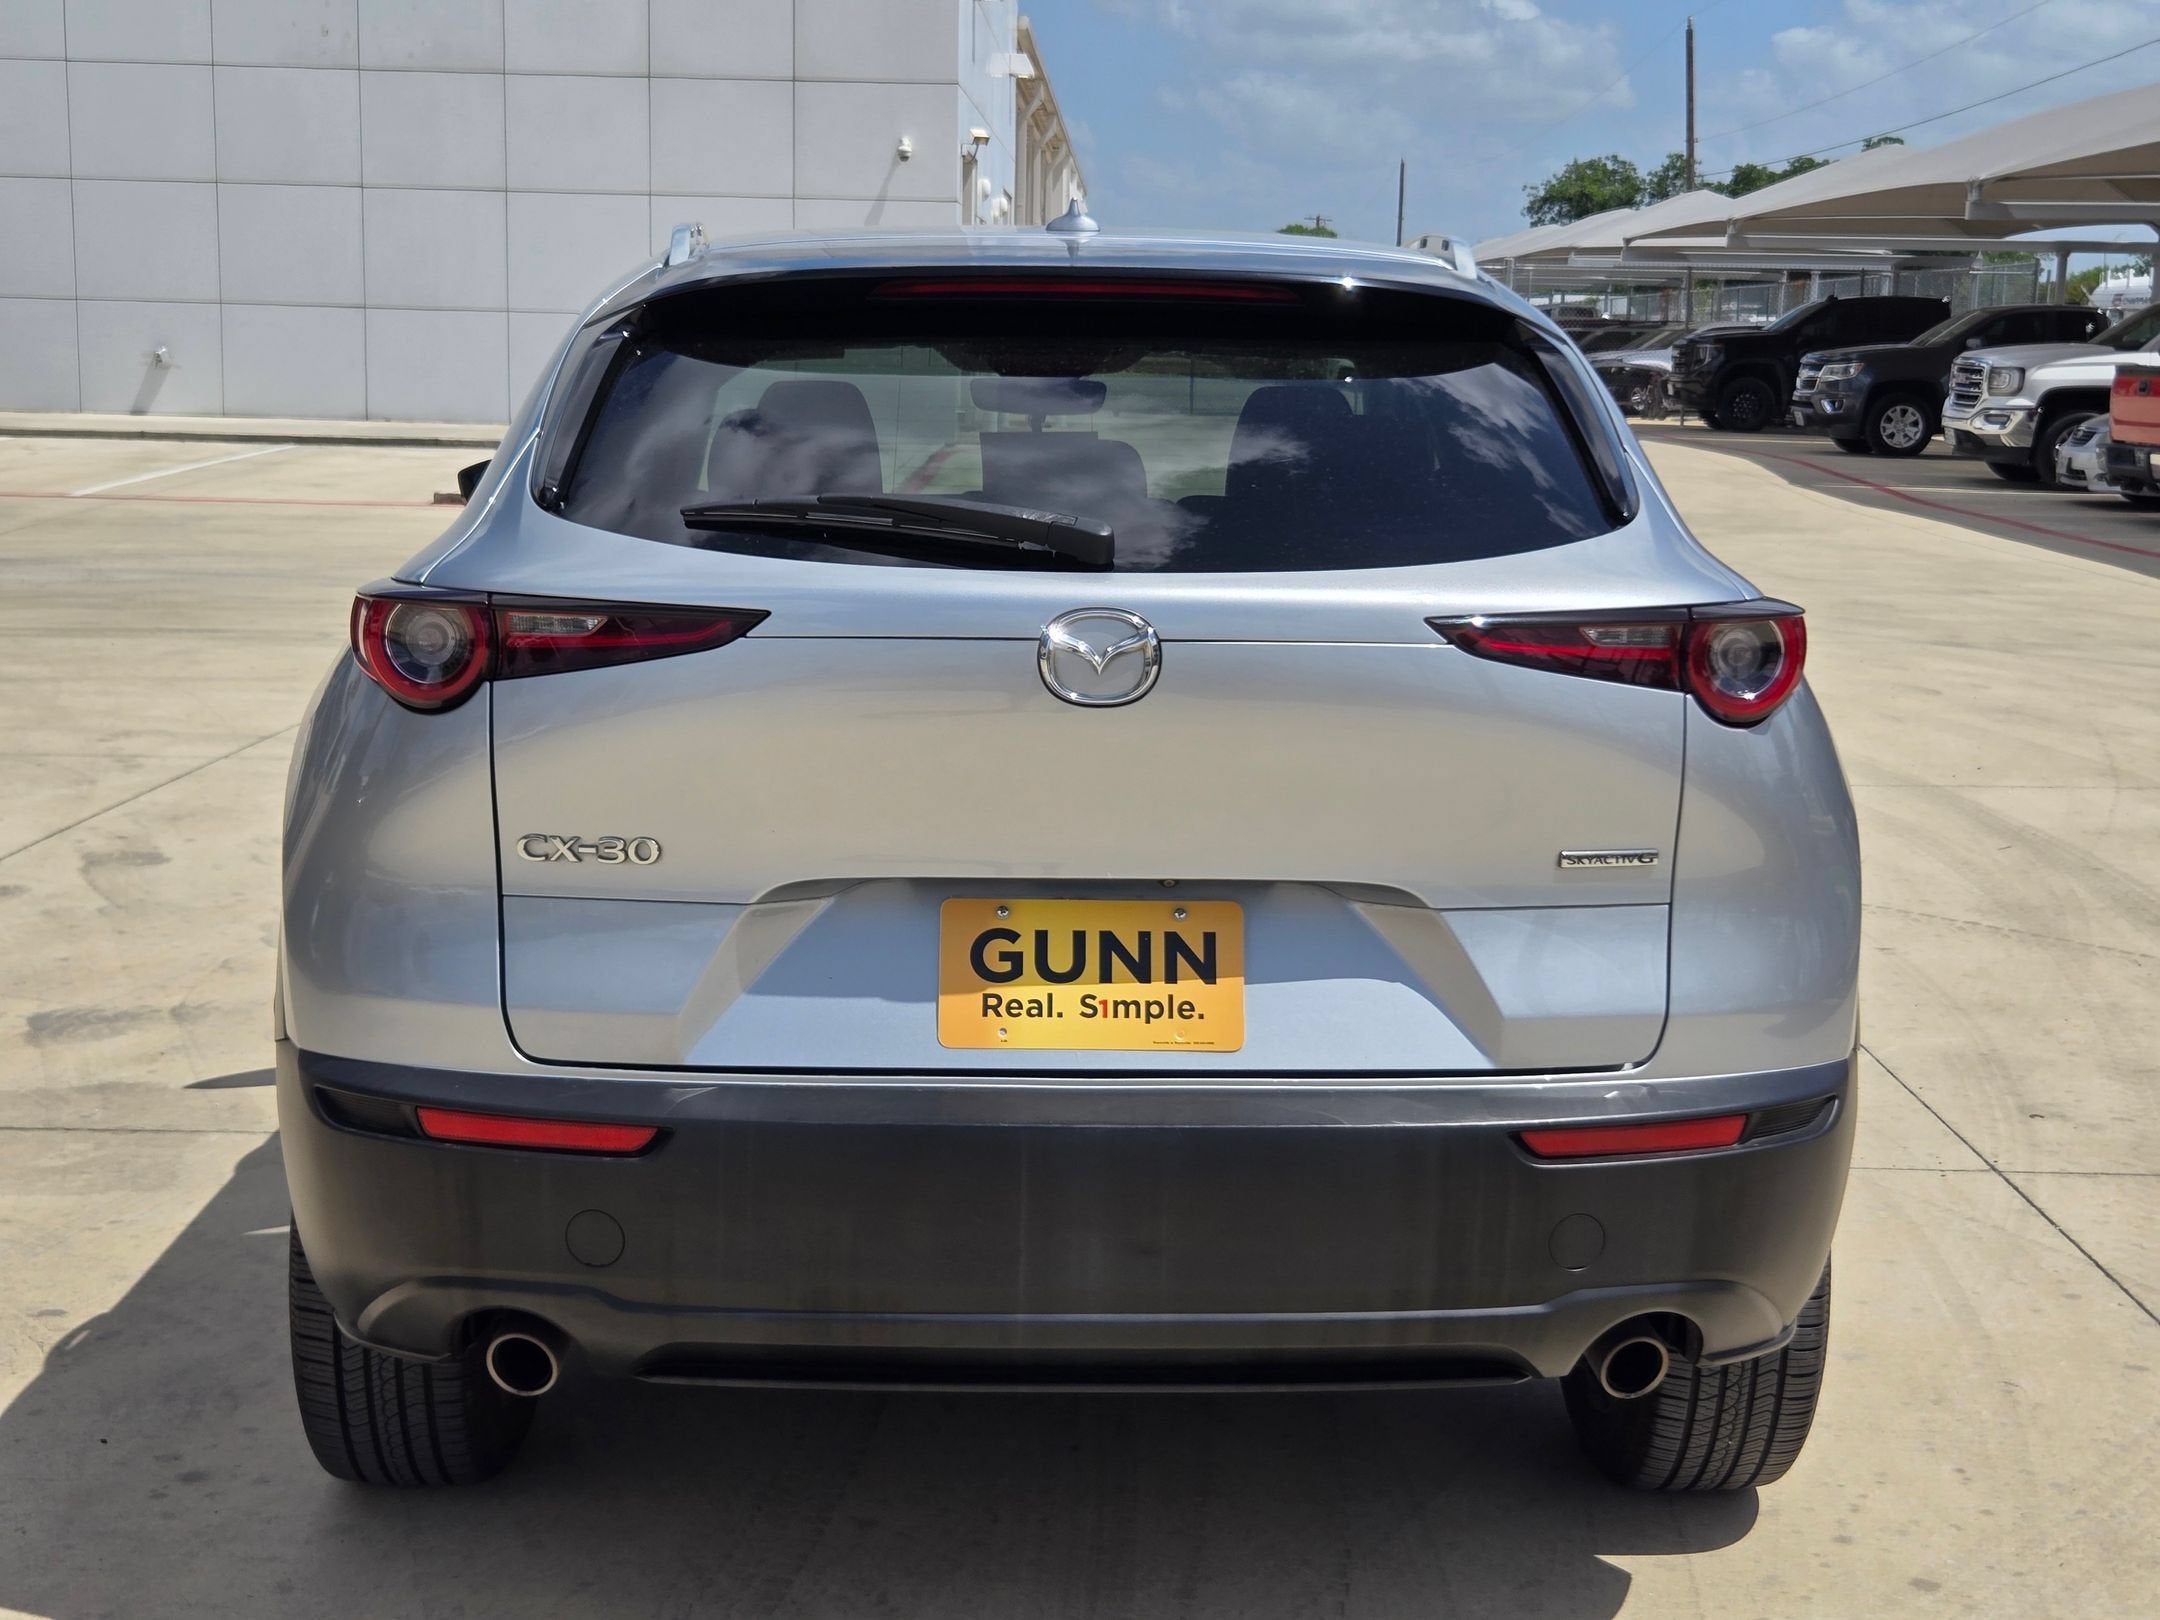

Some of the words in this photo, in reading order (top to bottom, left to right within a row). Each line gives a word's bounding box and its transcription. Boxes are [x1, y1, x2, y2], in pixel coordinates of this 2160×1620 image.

[516, 833, 661, 865] CX-30
[969, 927, 1217, 985] GUNN
[981, 992, 1063, 1018] Real.
